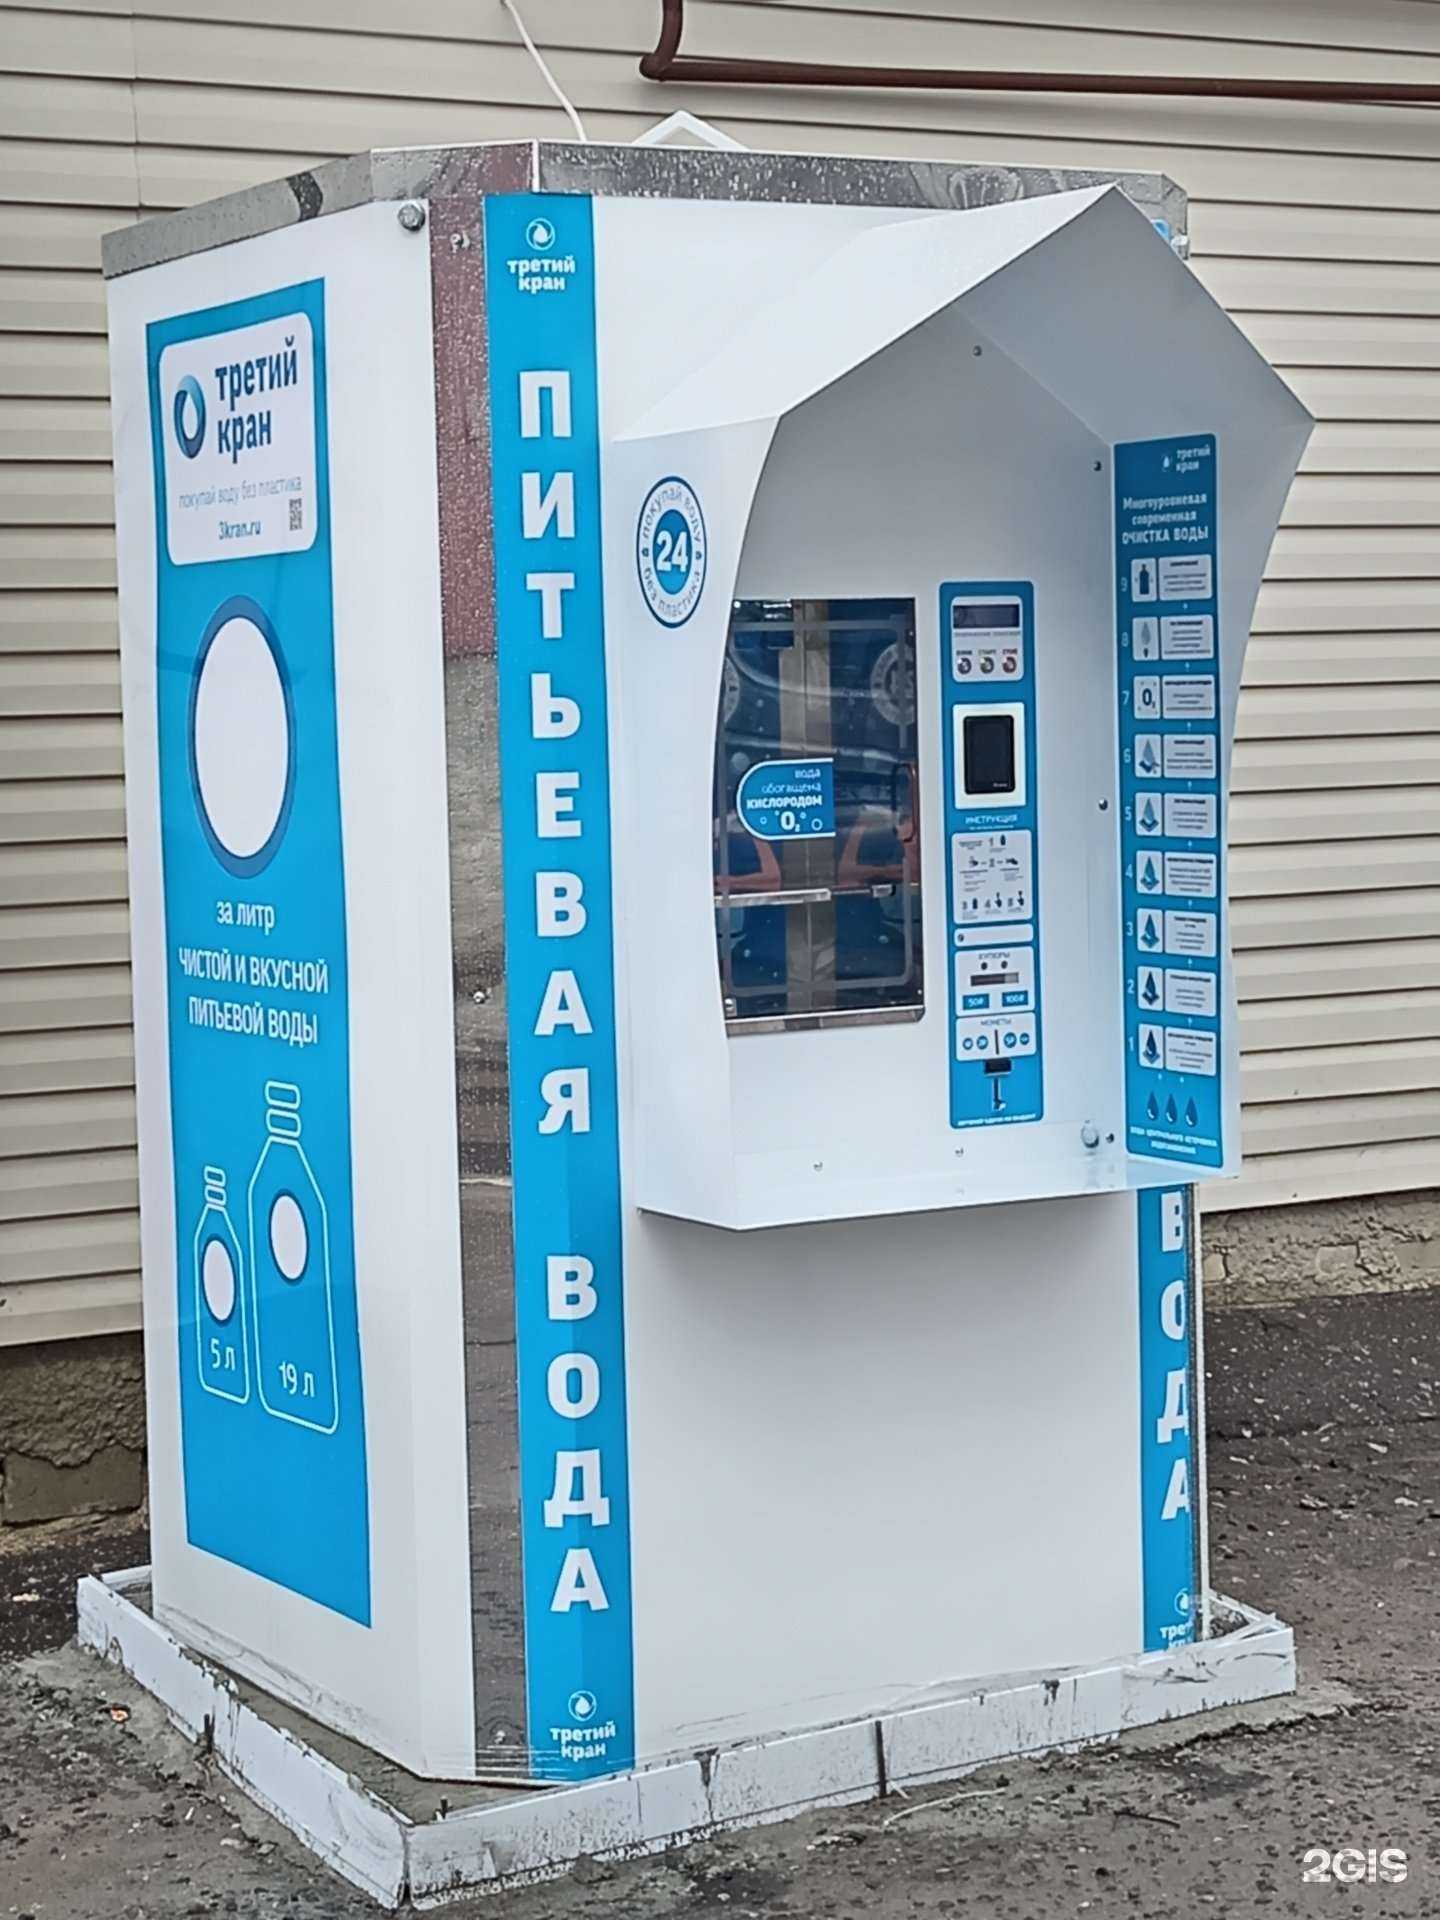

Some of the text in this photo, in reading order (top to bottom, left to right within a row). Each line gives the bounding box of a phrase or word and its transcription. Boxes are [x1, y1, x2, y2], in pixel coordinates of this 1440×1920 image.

[507, 255, 576, 277] третий
[518, 276, 566, 294] кран
[214, 335, 298, 412] третий
[217, 410, 272, 464] кран
[656, 529, 689, 573] 24
[519, 370, 593, 1135] ПИТЬЕВАЯ
[216, 901, 275, 936] за литр
[179, 947, 329, 994] ЧИСТОЙ И ВКУСНОЙ
[1127, 979, 1135, 994] 2
[188, 996, 318, 1048] ПИТЬЕВОЙ ВОДЫ
[211, 1338, 236, 1371] 5 л
[279, 1360, 315, 1398] 19 л
[544, 1255, 610, 1612] ВОДА
[549, 1720, 616, 1744] третий
[561, 1742, 606, 1763] кран
